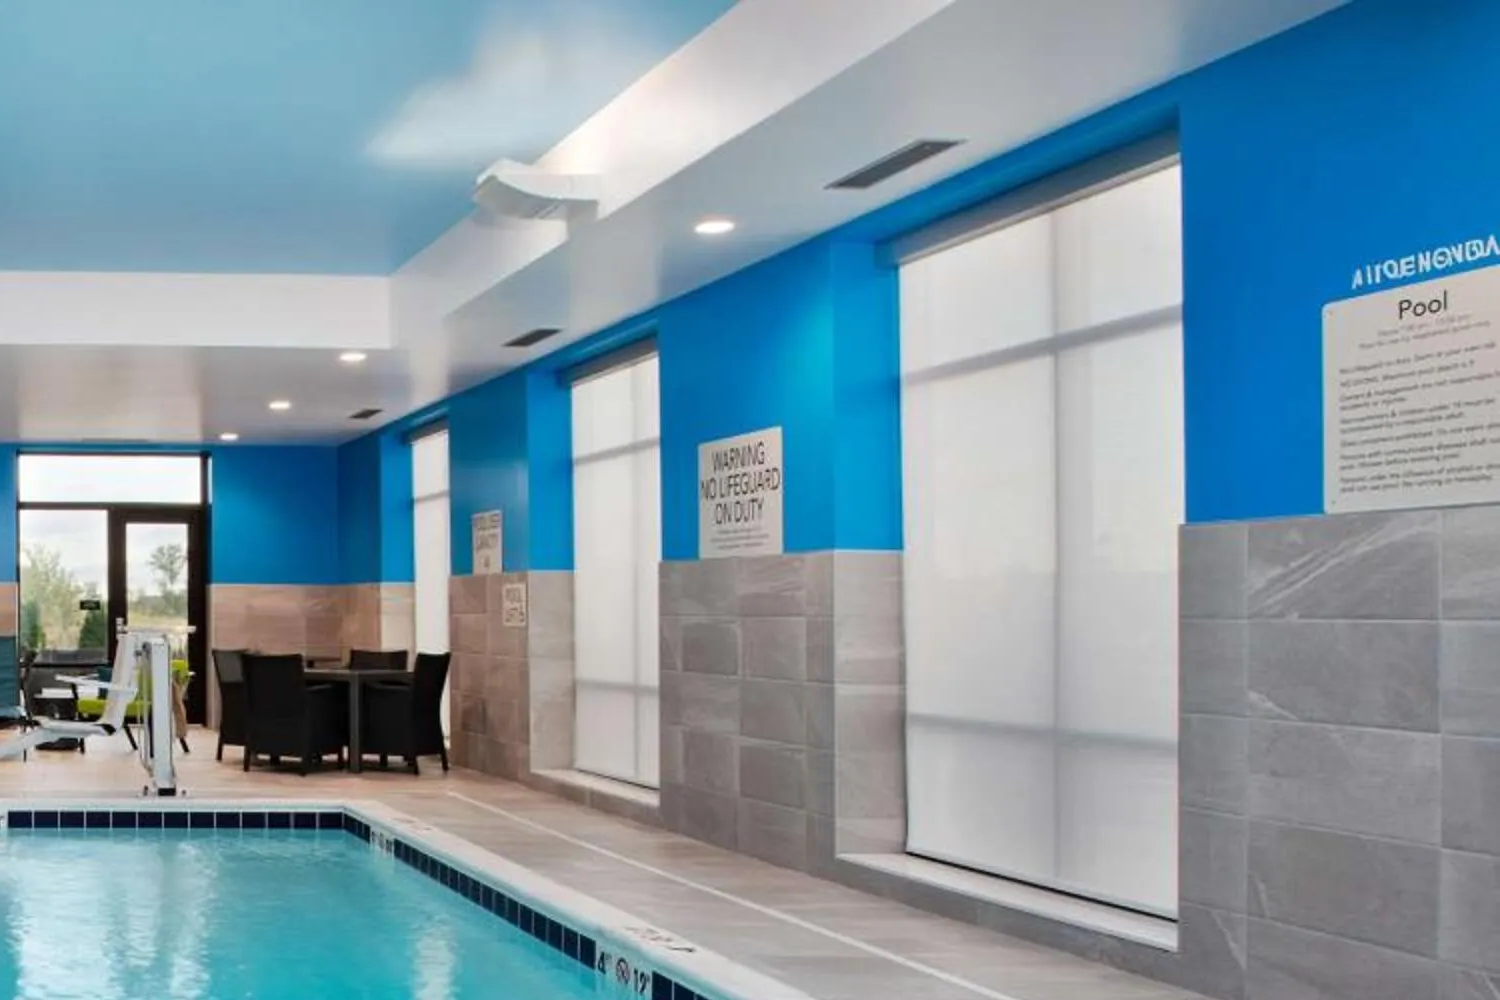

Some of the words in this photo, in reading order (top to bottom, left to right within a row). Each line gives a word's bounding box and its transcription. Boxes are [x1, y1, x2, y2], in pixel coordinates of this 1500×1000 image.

[1398, 290, 1448, 320] Pool
[711, 440, 765, 474] WARNING
[701, 476, 717, 501] NO
[719, 466, 781, 500] LIFEGUARD
[715, 502, 732, 525] ON
[734, 497, 765, 523] DUTY
